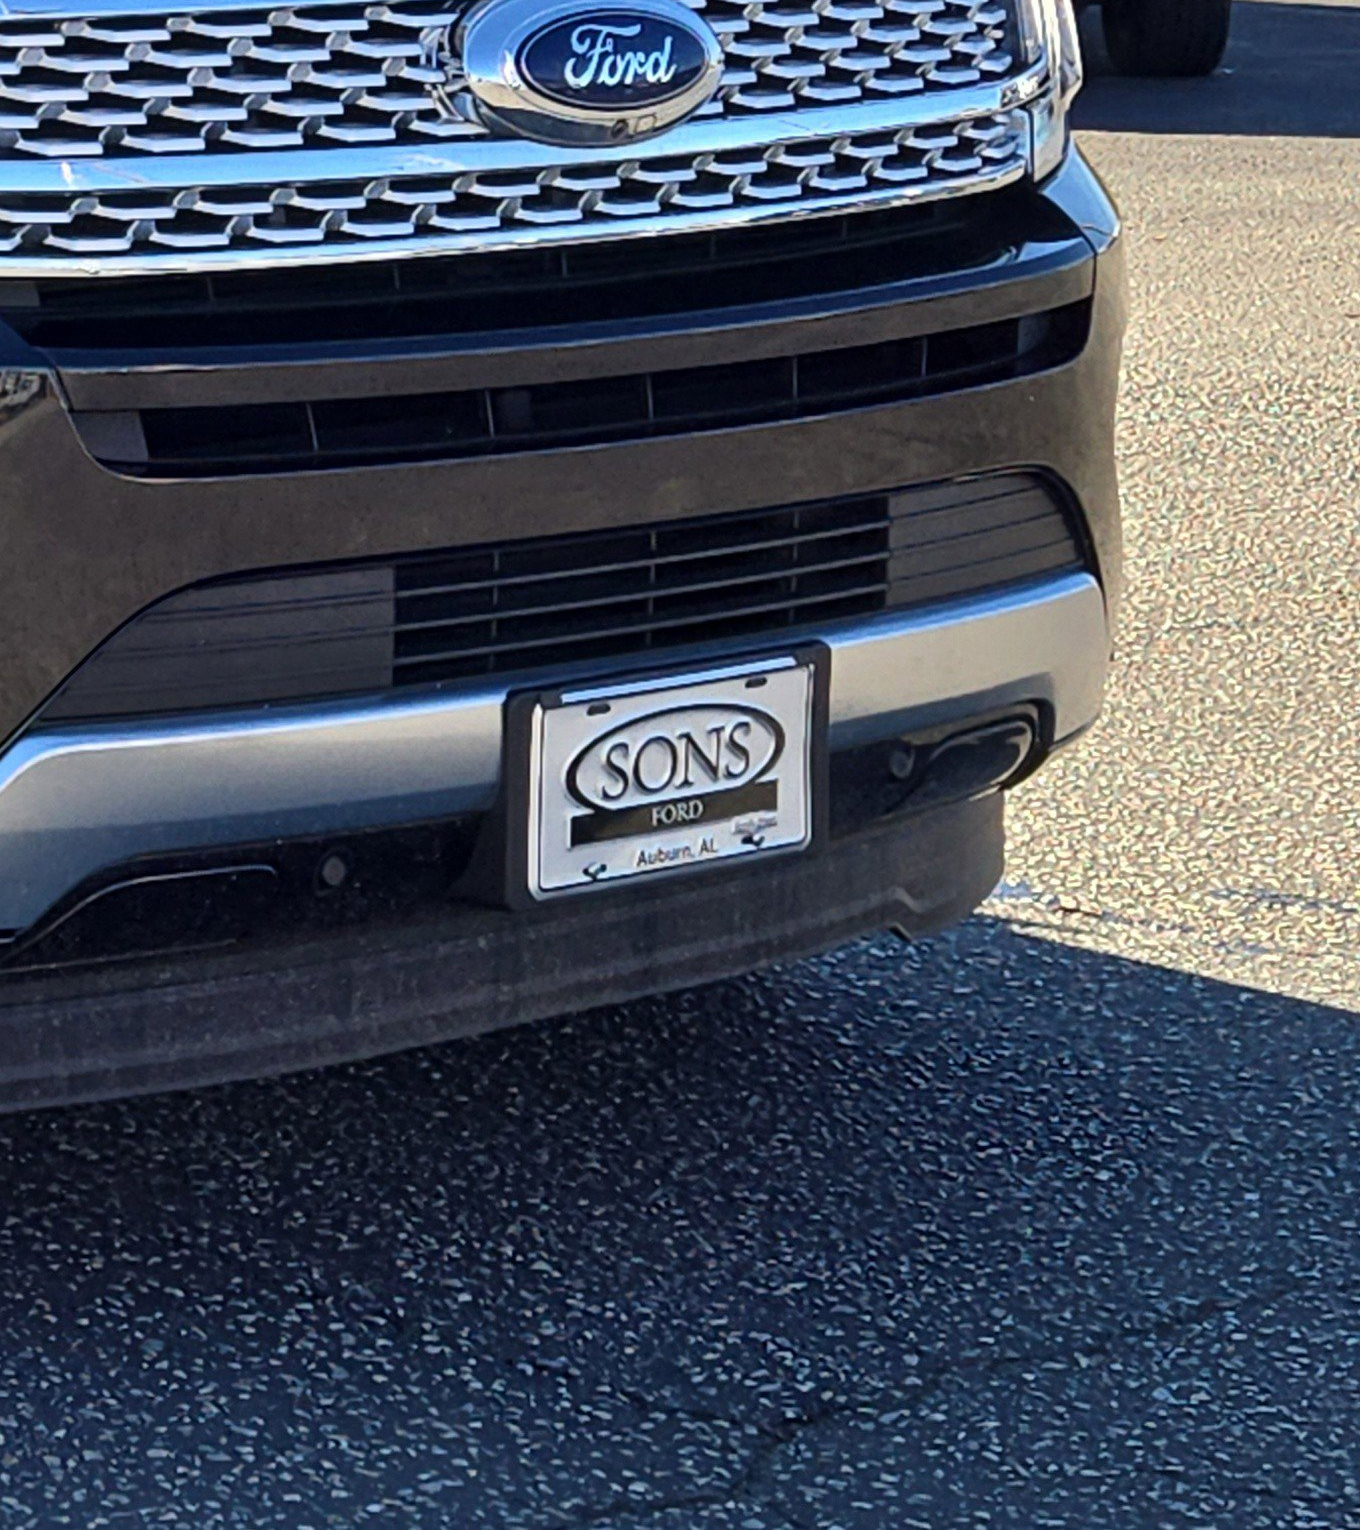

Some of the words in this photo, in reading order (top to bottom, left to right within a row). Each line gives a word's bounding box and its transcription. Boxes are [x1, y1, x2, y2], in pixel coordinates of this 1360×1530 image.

[564, 23, 677, 89] Ford
[601, 721, 752, 801] SONS
[651, 799, 704, 827] FORD
[700, 838, 719, 856] AL
